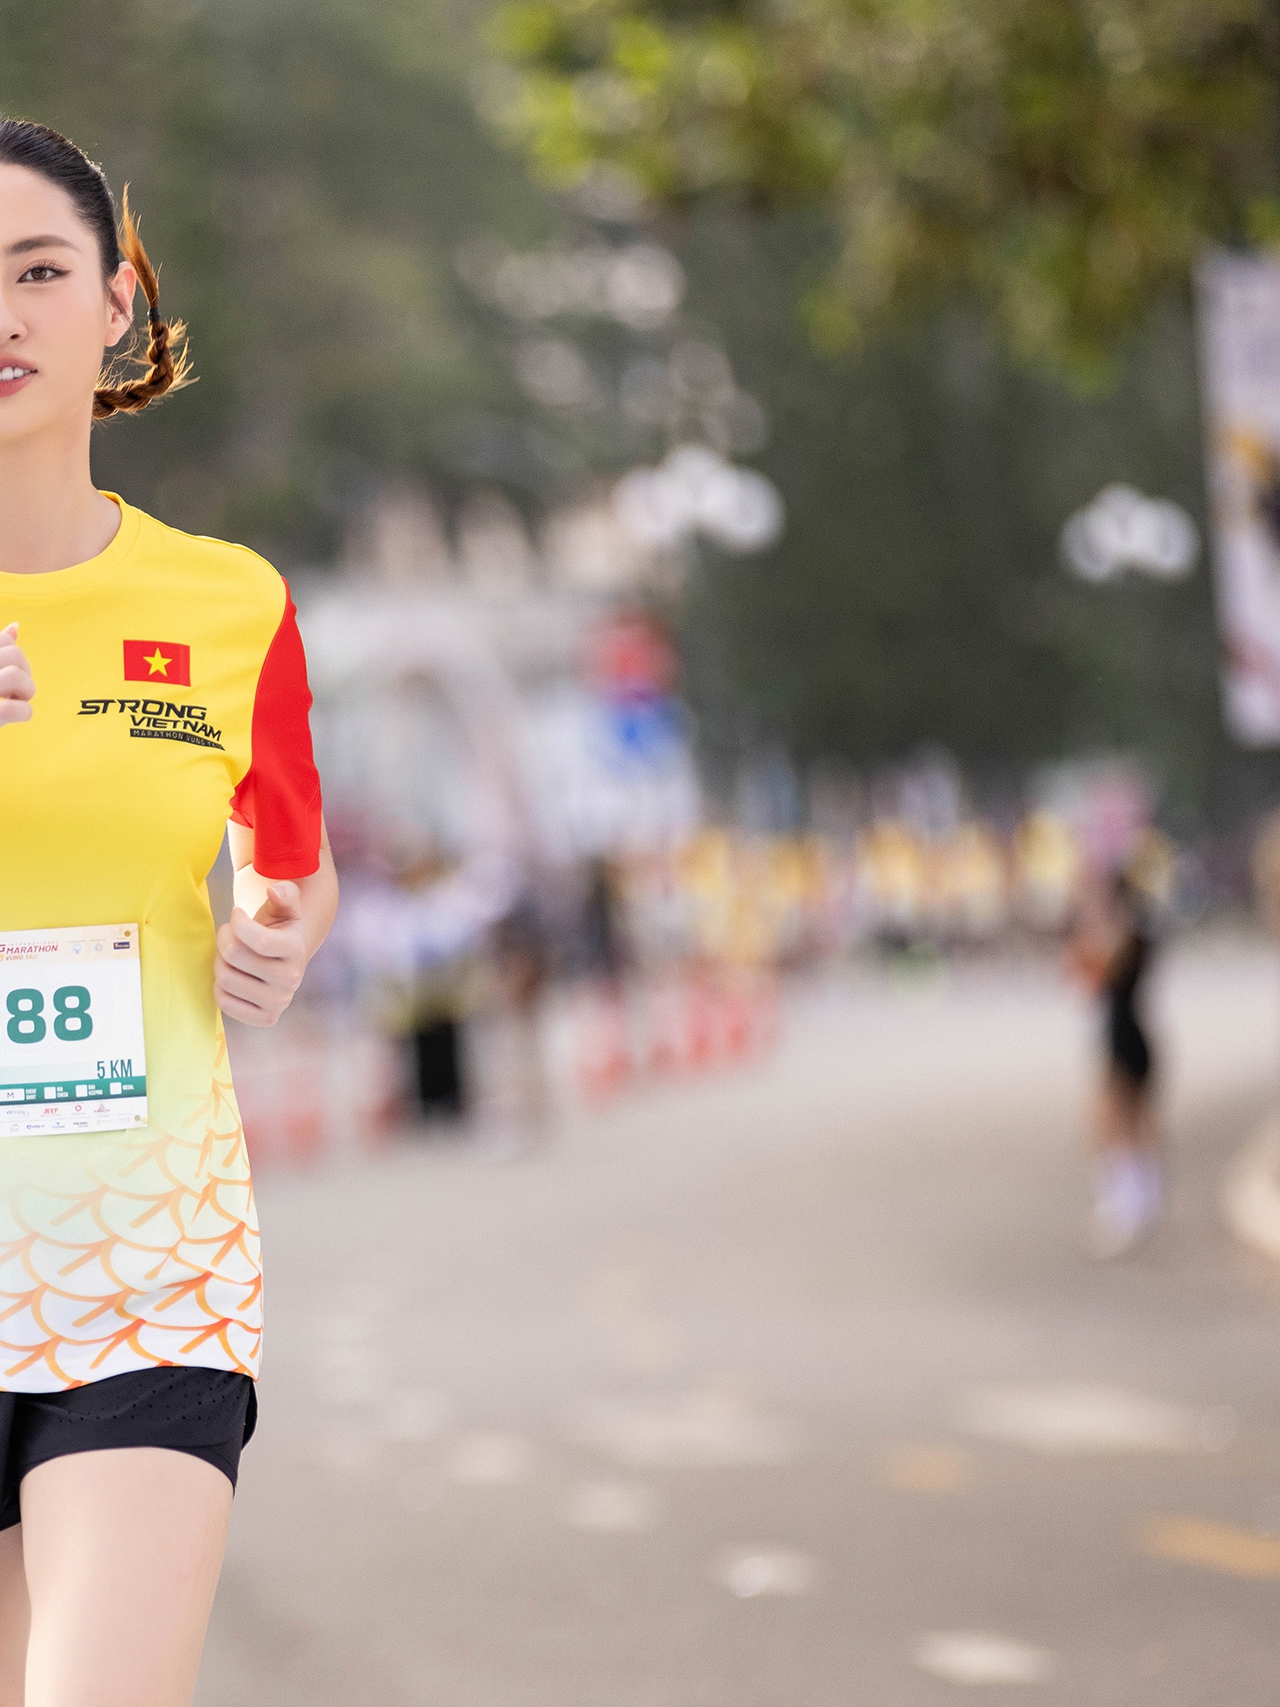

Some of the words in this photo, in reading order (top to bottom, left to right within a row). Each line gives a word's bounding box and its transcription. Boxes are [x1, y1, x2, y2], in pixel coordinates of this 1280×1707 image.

[76, 698, 208, 721] STRONG
[133, 729, 184, 740] MARATHON
[6, 943, 59, 955] MARATHON
[96, 1060, 106, 1079] 5
[110, 1058, 133, 1079] KM
